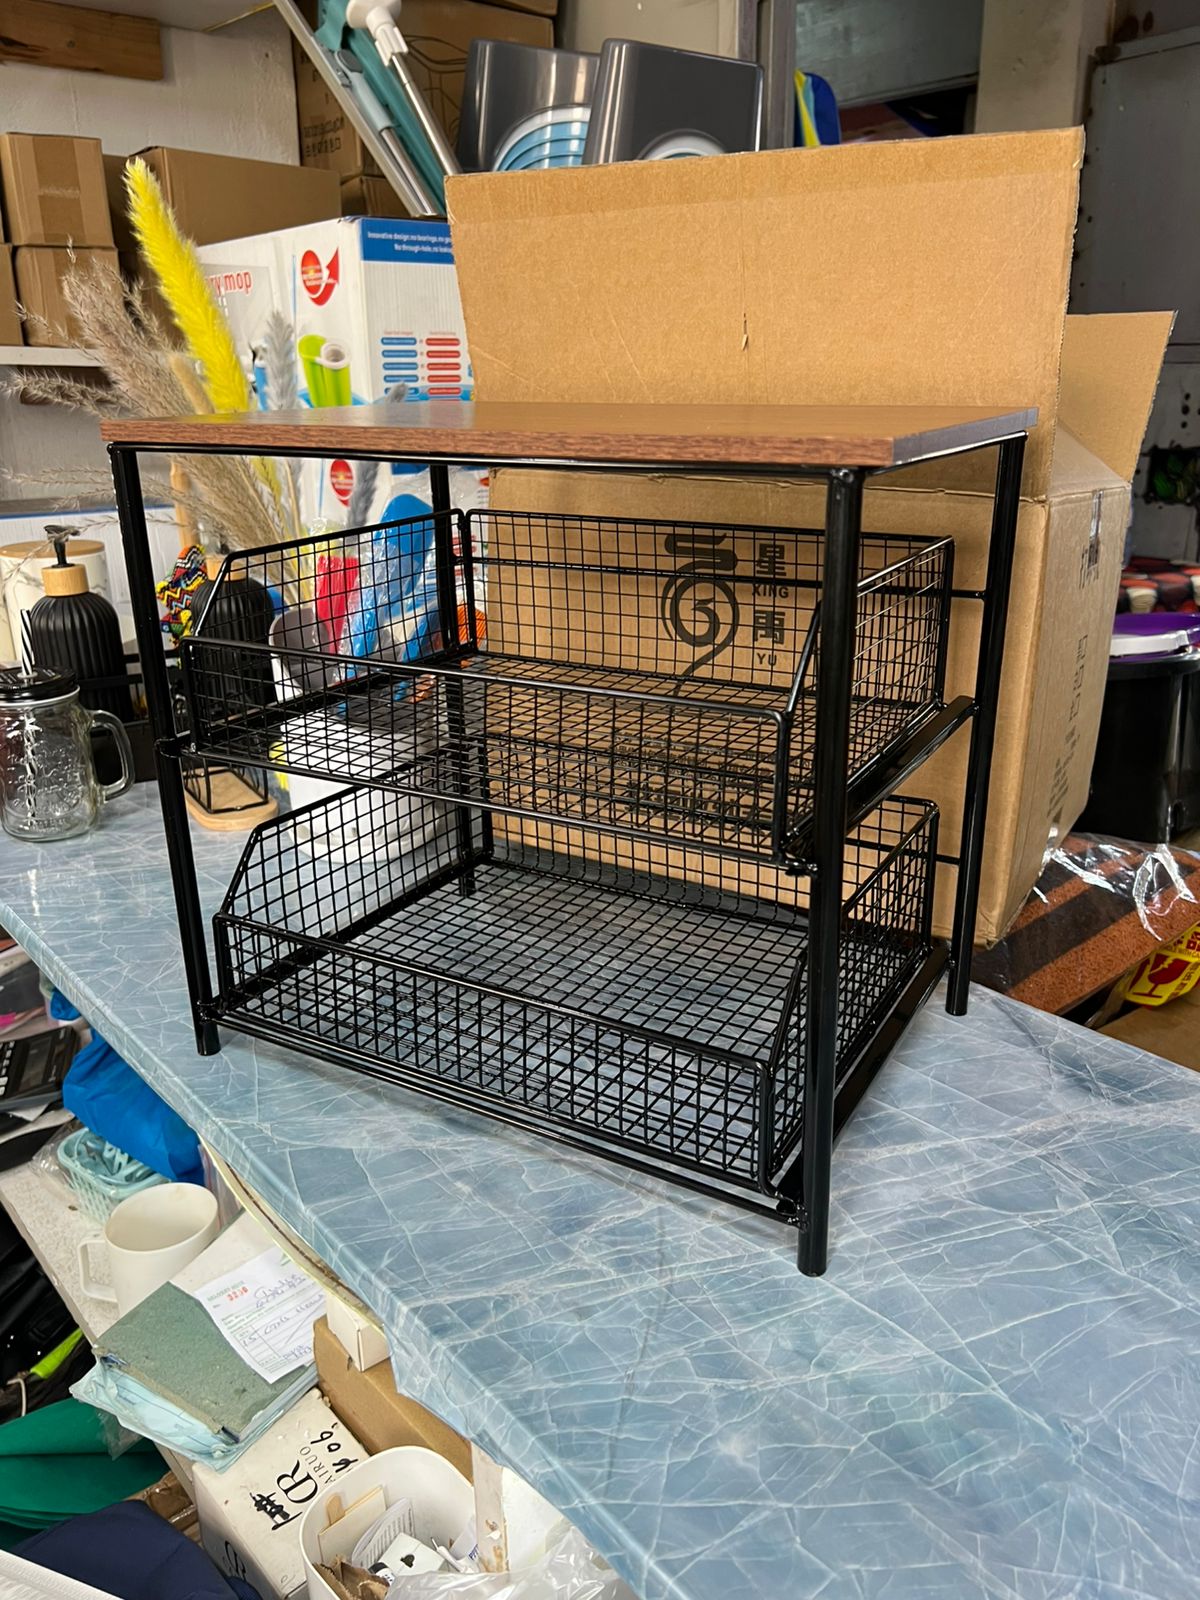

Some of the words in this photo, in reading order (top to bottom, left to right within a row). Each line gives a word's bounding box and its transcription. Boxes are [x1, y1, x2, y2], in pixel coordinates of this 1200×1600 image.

[223, 271, 252, 295] mop
[756, 543, 787, 577] 星
[752, 583, 789, 599] XING
[756, 652, 778, 667] YU
[299, 1445, 336, 1485] AIRUO
